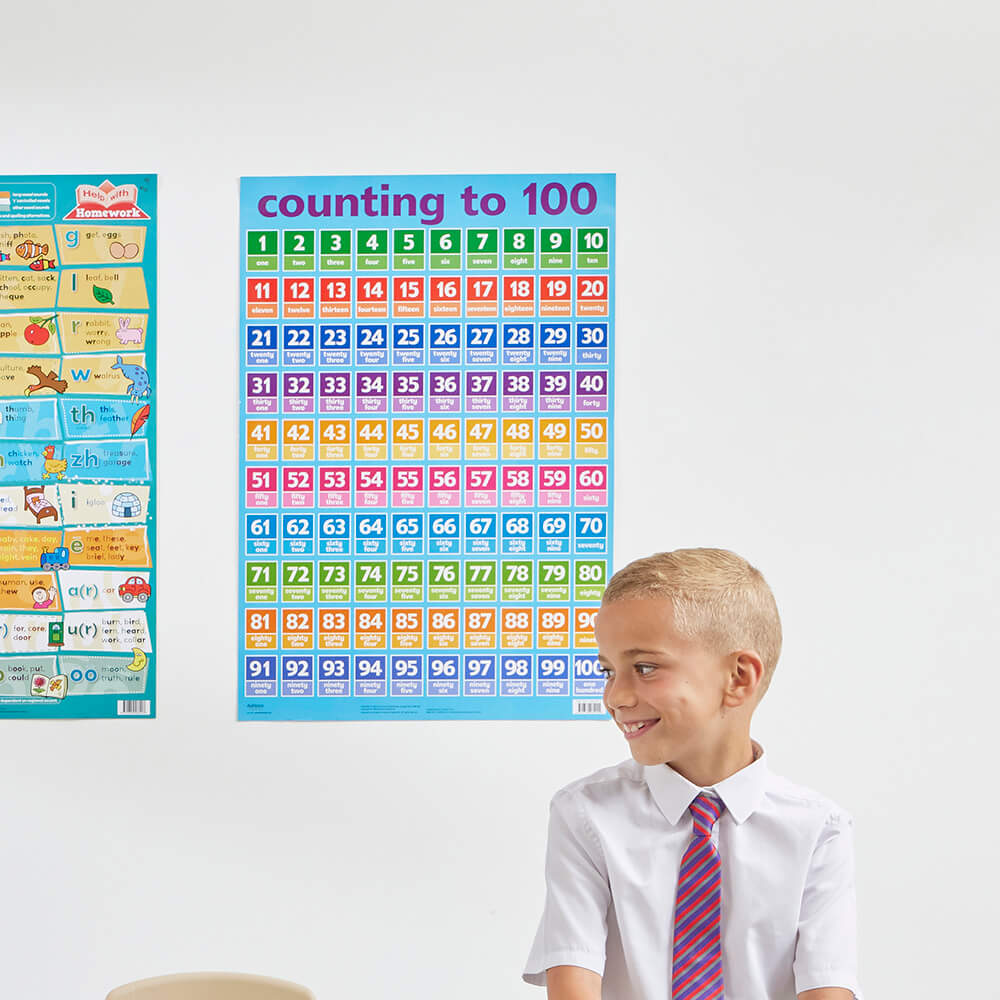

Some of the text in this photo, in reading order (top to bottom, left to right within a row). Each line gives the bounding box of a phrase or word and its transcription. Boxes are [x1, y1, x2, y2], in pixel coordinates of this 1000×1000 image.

[83, 189, 129, 201] Help with
[258, 182, 597, 225] counting to 100
[76, 208, 140, 218] Homework
[66, 230, 78, 248] g
[258, 232, 604, 252] 1 2 3 4 5 6 7 8 9 10
[72, 274, 76, 291] l
[72, 321, 79, 333] r
[251, 327, 604, 346] 21 22 23 24 25 26 27 28 29 30
[71, 369, 90, 381] w
[71, 406, 94, 423] th
[71, 450, 98, 466] zh
[251, 469, 604, 489] 51 52 53 54 55 56 57 58 59 60
[72, 491, 75, 508] i
[71, 670, 97, 681] oo
[249, 660, 270, 677] 91
[285, 660, 310, 677] 92
[322, 660, 345, 677] 93
[358, 659, 383, 677] 94
[394, 659, 418, 677] 95
[431, 659, 456, 677] 96
[467, 659, 492, 677] 97
[504, 659, 529, 676] 98
[540, 659, 566, 676] 99
